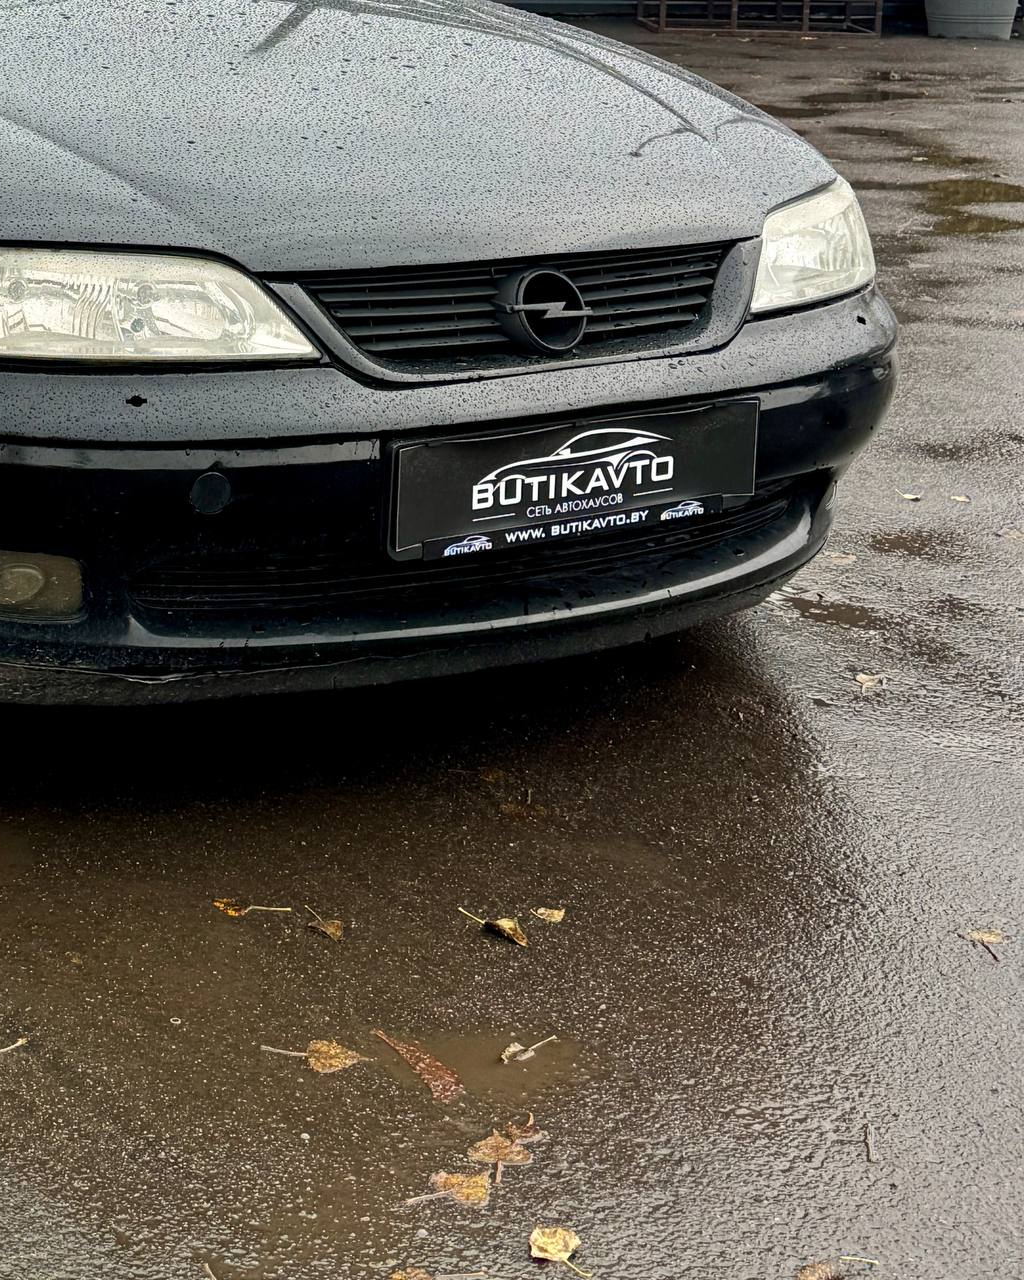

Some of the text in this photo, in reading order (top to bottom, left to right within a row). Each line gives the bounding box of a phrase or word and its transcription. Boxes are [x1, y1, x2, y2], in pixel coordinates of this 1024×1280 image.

[472, 455, 674, 510] BUTIKAVTO
[527, 494, 624, 518] СЕТЬ АВТОХАУСОВ
[660, 507, 704, 521] BUTIKAVTO
[505, 510, 649, 544] WWW. BUTIKAVTO.BY
[443, 542, 493, 557] BUTIKAVTO
